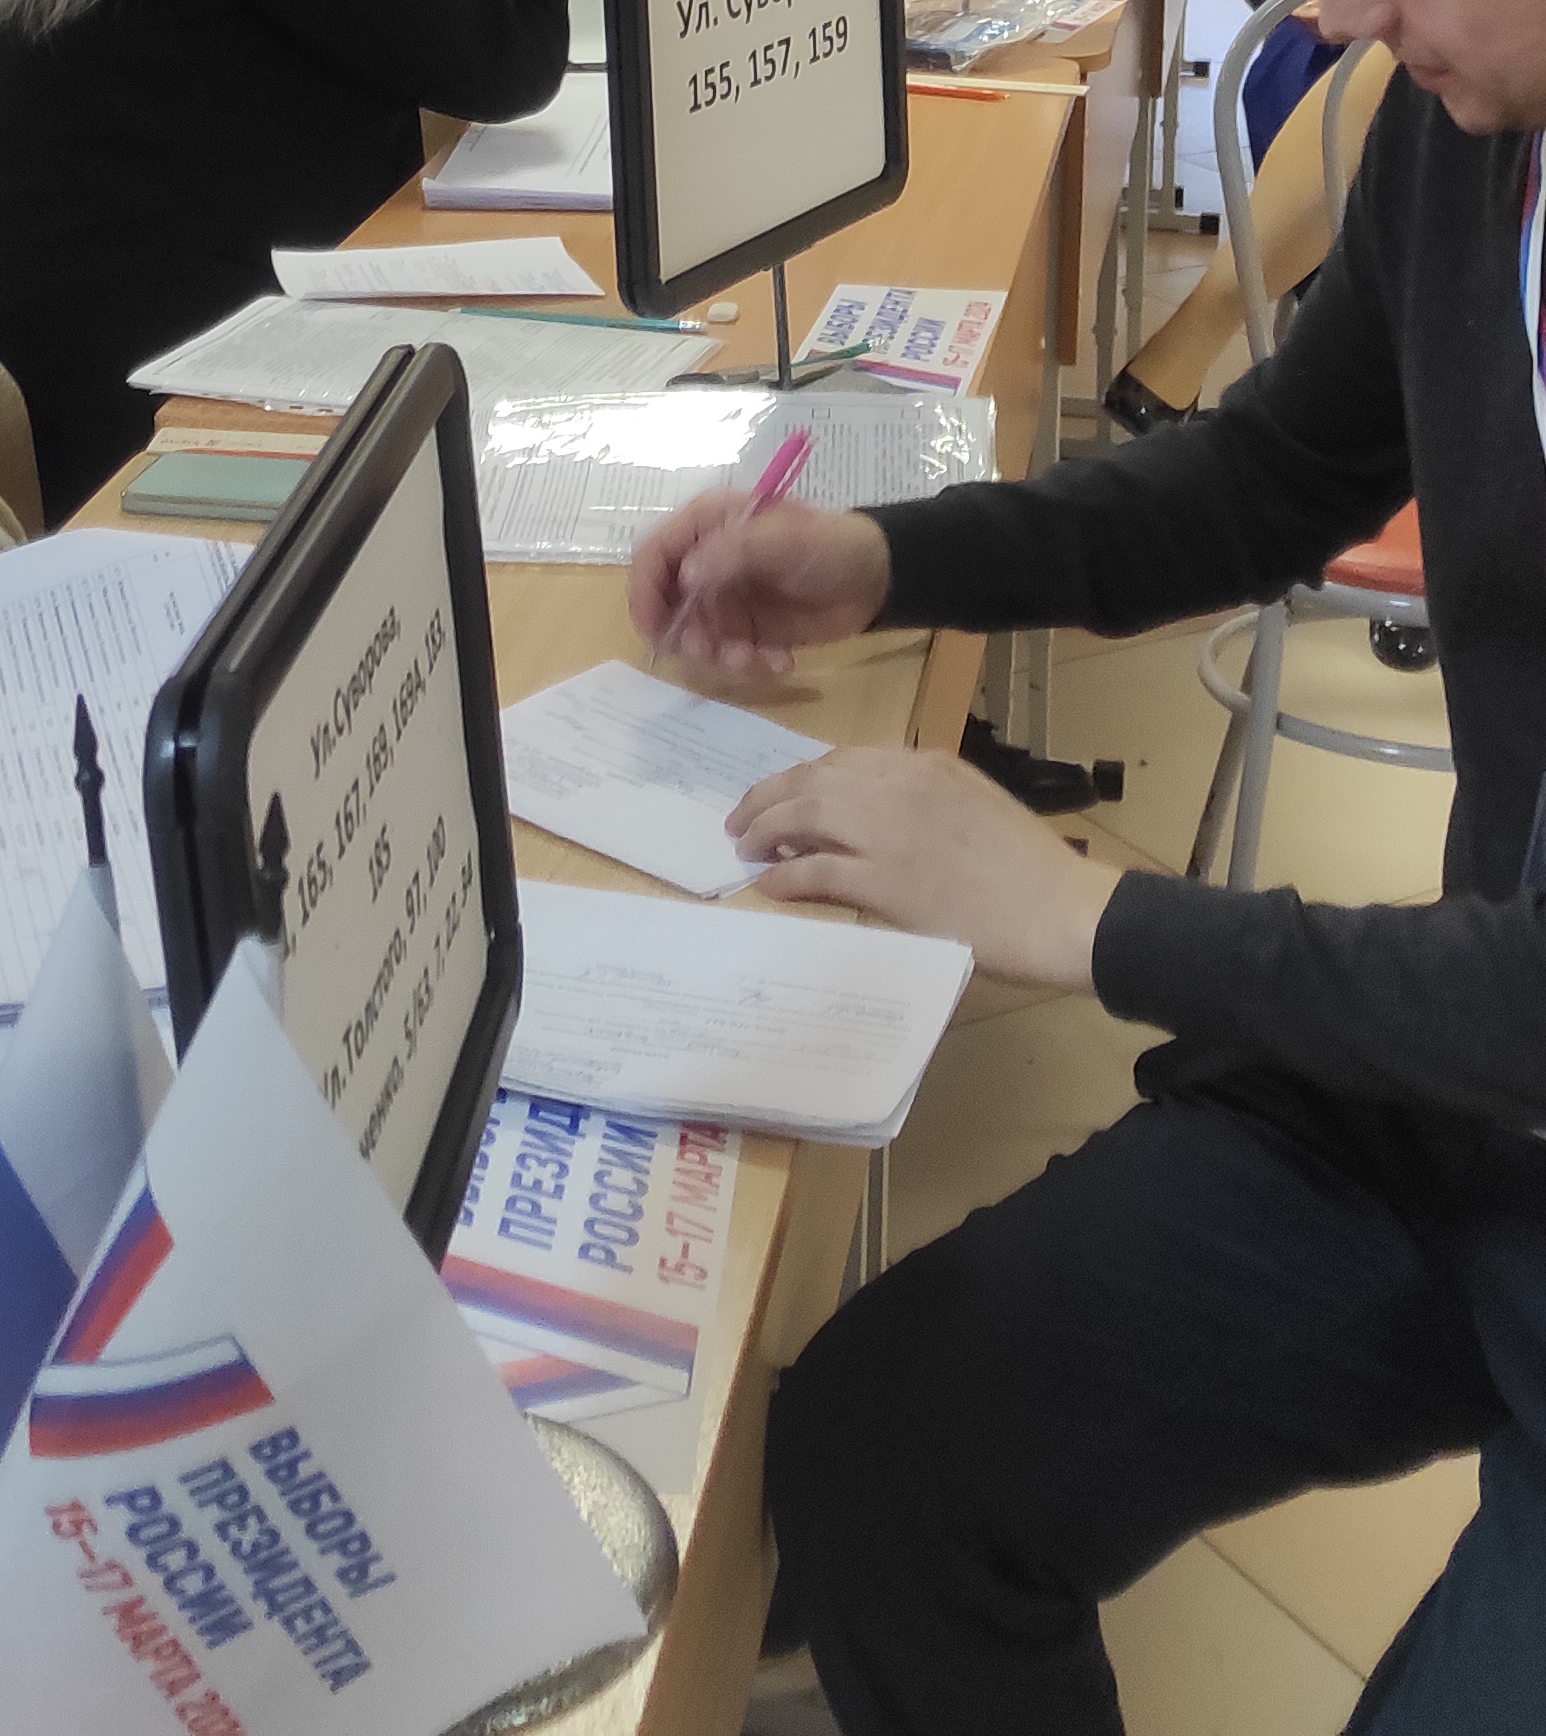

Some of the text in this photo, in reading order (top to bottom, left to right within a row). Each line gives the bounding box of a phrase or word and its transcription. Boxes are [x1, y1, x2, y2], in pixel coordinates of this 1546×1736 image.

[688, 15, 848, 114] 155, 157, 159
[816, 298, 869, 346] ВЫБОРЫ
[900, 317, 948, 362] РОССИИ
[335, 777, 366, 860] 167,
[366, 722, 394, 799] 169,
[405, 869, 428, 935] 97,
[497, 1096, 592, 1251] ПРЕЗИД
[577, 1120, 659, 1275] РОССИИ
[670, 1120, 731, 1213] МАРТА
[105, 1485, 256, 1651] РОССИИ
[248, 1425, 398, 1599] ВЫБОРЫ
[177, 1455, 373, 1695] ПРЕЗИДЕНТА
[103, 1594, 202, 1701] МАРТА
